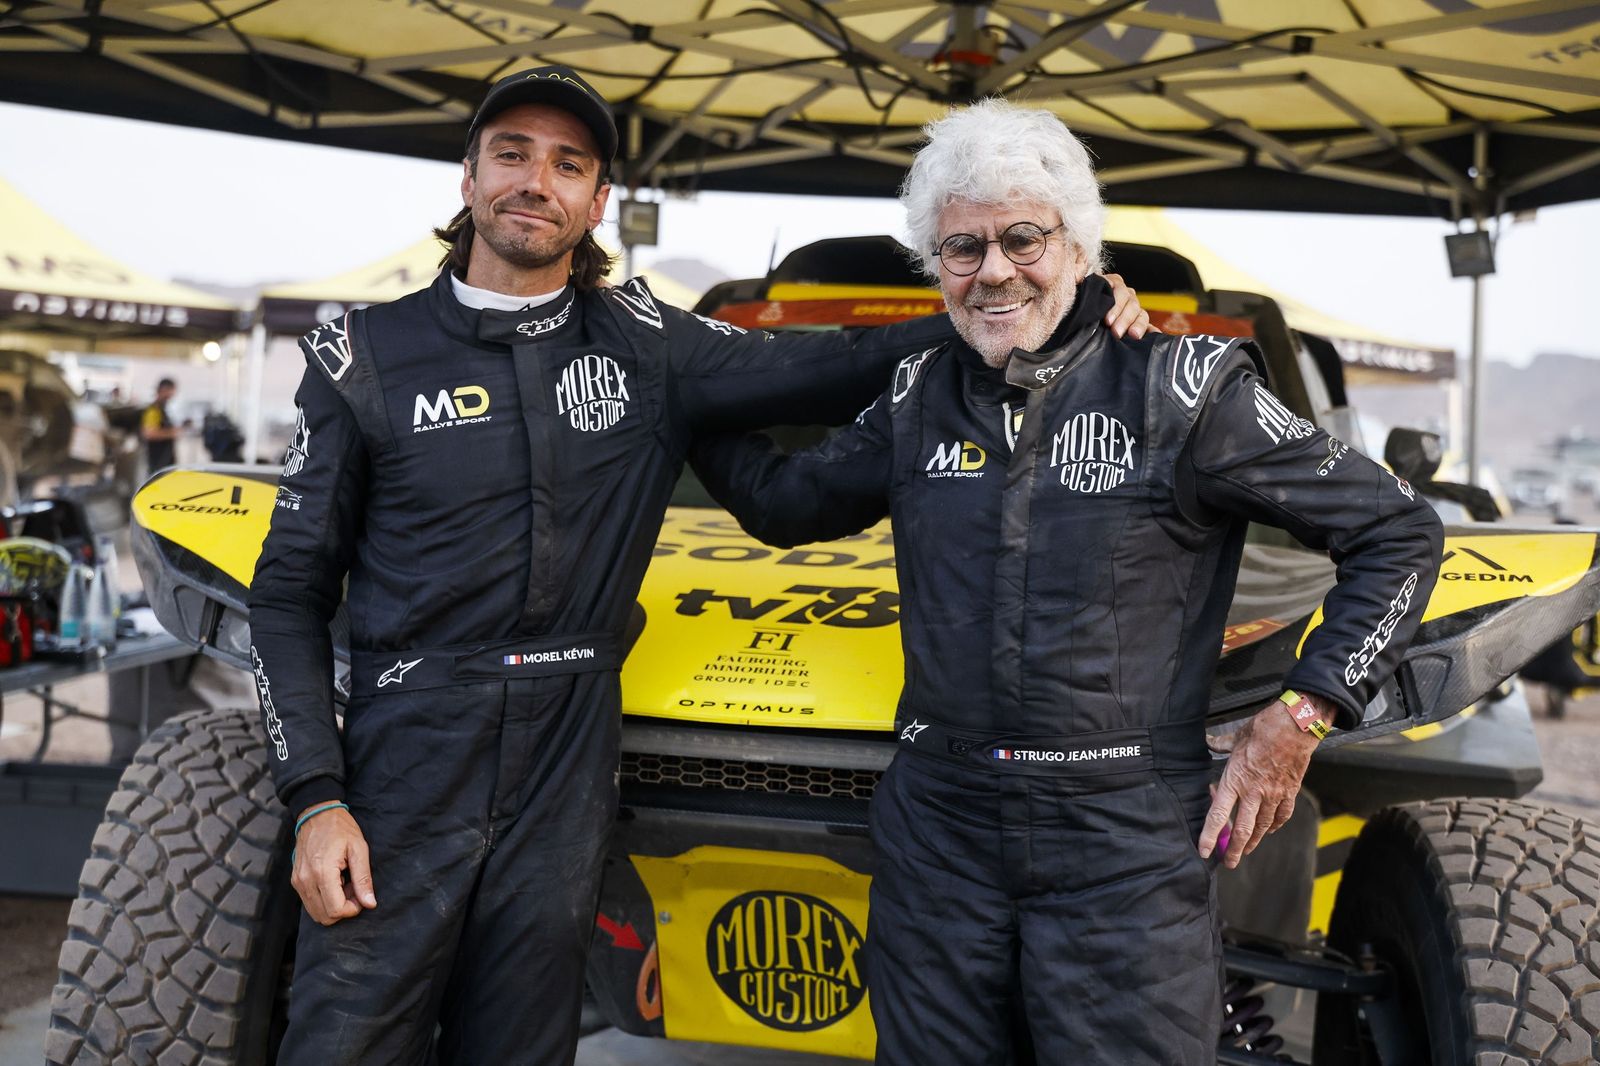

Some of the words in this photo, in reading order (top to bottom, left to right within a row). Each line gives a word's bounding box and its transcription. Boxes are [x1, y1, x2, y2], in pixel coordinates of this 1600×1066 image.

[555, 354, 630, 416] MOREX
[413, 385, 490, 426] MD
[570, 399, 626, 432] CUSTOM
[413, 421, 453, 433] RALLYE
[455, 416, 492, 426] SPORT
[1050, 411, 1136, 471] MOREX
[925, 440, 986, 471] MD
[1319, 443, 1349, 477] OPTIM
[1060, 461, 1125, 494] CUSTOM
[149, 503, 250, 516] COGEDIM
[1441, 572, 1534, 583] GEDIM
[743, 631, 799, 652] FI
[522, 651, 562, 664] MOREL
[563, 647, 595, 660] KÉVIN
[716, 655, 807, 668] FAUBOURG
[693, 675, 756, 685] GROUPE
[704, 663, 809, 677] IMMOBILIER
[678, 699, 815, 715] OPTIMUS
[1013, 749, 1065, 762] STRUGO
[1066, 745, 1141, 762] JEAN-PIERRE
[716, 895, 862, 989] MOREX
[739, 970, 850, 1025] CUSTOM
